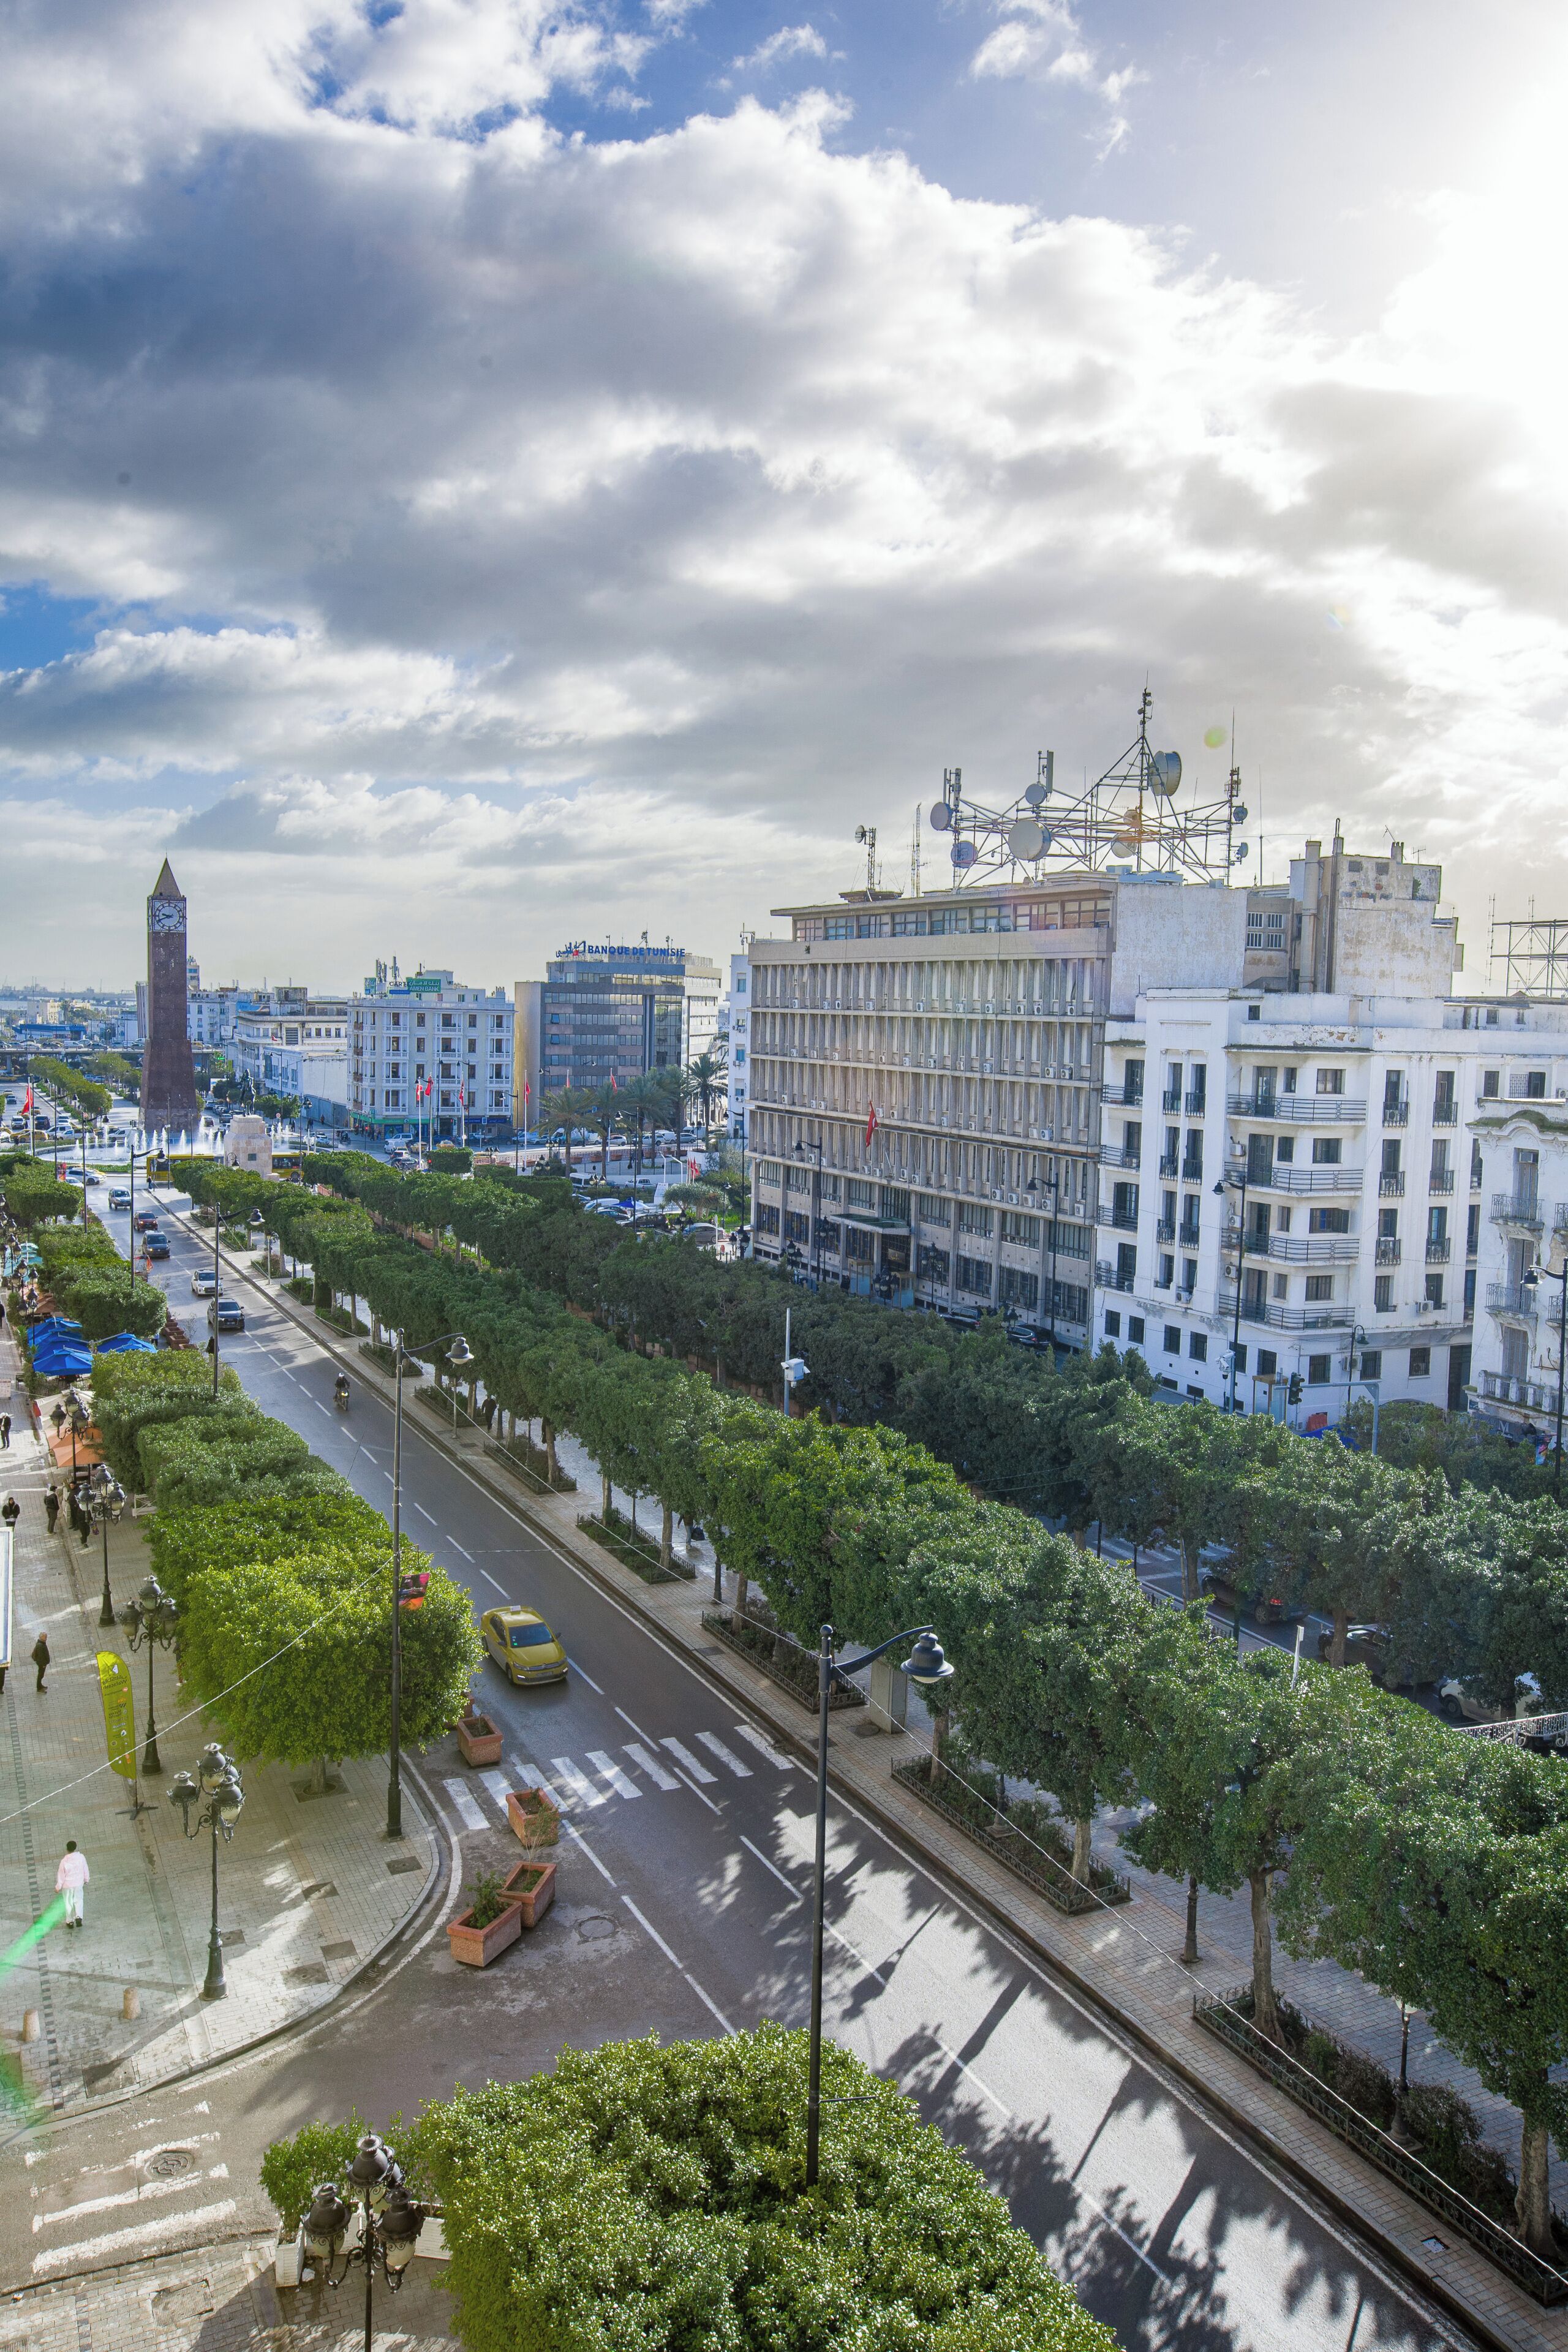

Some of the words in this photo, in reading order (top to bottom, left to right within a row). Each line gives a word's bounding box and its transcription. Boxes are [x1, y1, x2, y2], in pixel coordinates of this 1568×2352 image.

[588, 945, 630, 954] BANQUE
[633, 947, 644, 956] DE
[646, 948, 685, 957] TUNISIE
